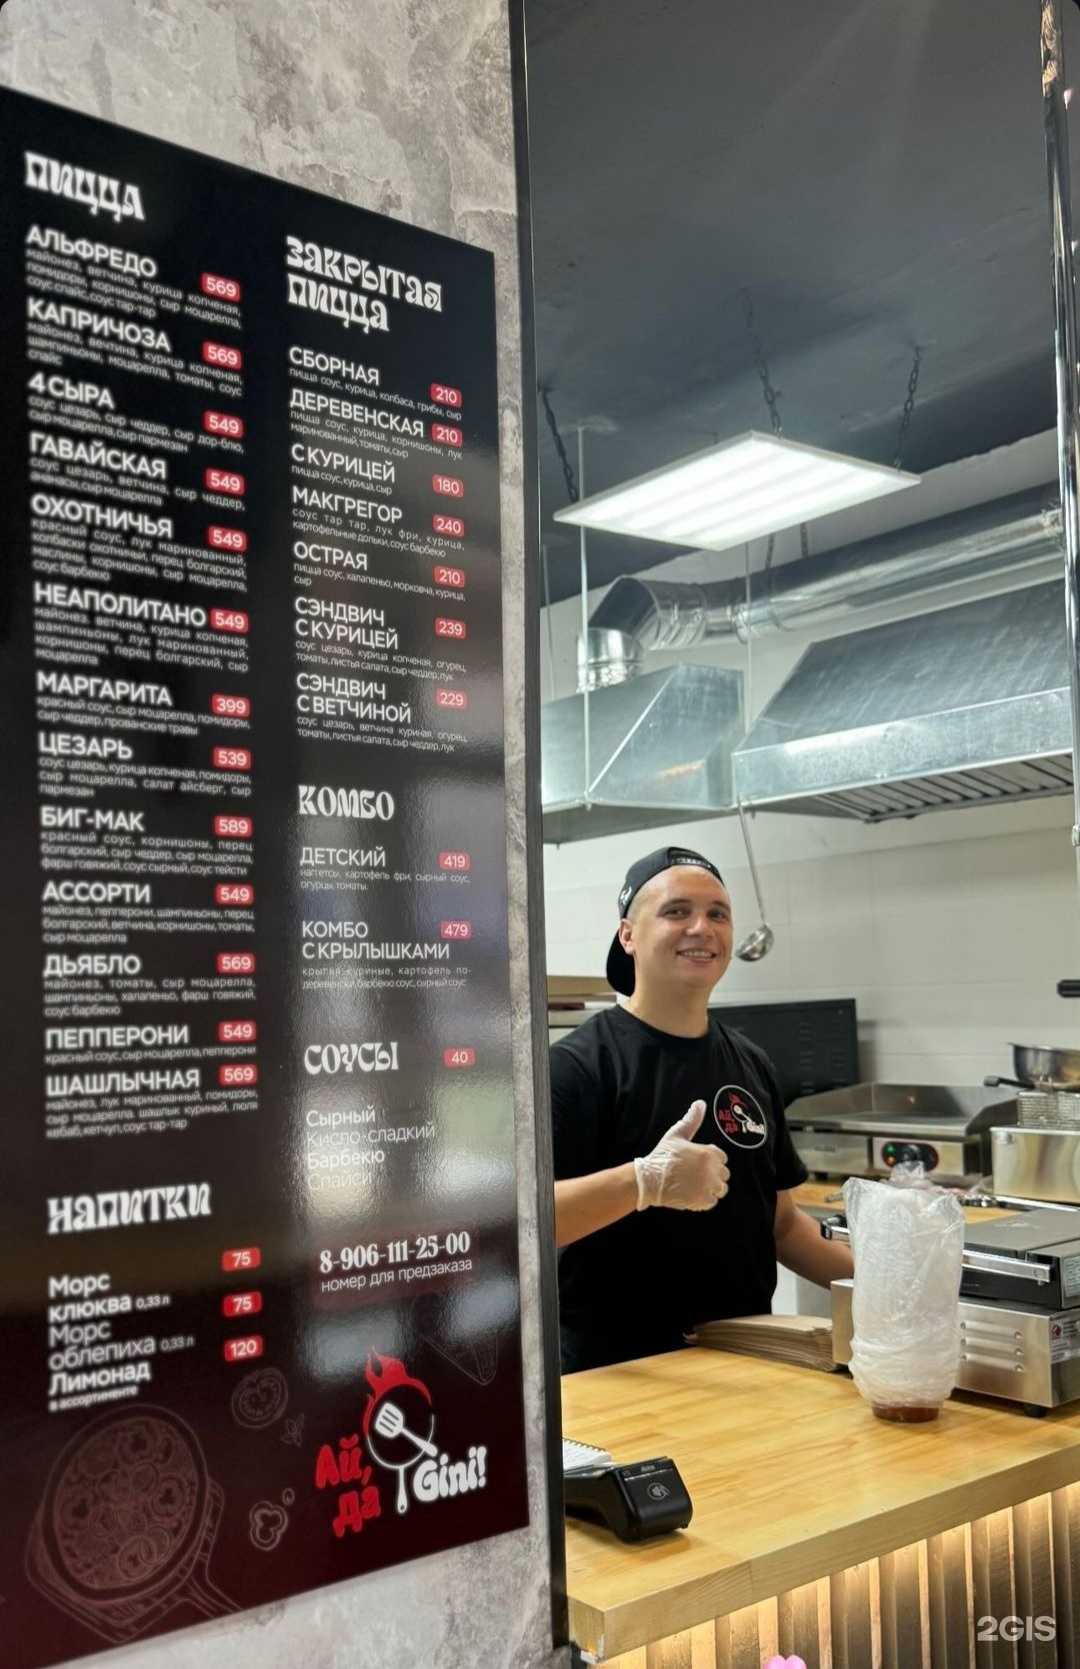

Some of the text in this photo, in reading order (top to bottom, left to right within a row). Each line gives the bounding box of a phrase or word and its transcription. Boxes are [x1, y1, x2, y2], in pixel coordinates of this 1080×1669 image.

[25, 224, 157, 278] АЛЬФРЕДО
[206, 276, 237, 297] 569
[27, 296, 171, 352] КАПРИЧОЗА
[207, 344, 238, 365] 569
[288, 345, 379, 386] СБОРНАЯ
[28, 371, 115, 409] 4 СЫРА
[435, 386, 457, 404] 210
[208, 414, 239, 434] 549
[289, 387, 424, 438] ДЕРЕВЕНСКАЯ
[436, 426, 458, 443] 210
[29, 431, 166, 479] ГАВАЙСКАЯ
[290, 442, 395, 483] С КУРИЦЕЙ
[210, 471, 240, 492] 549
[437, 477, 459, 494] 180
[30, 492, 172, 538] ОХОТНИЧЬЯ
[292, 485, 403, 524] МАКГРЕГОР
[436, 517, 461, 534] 240
[212, 528, 243, 548] 549
[293, 540, 367, 571] ОСТРАЯ
[439, 569, 461, 585] 210
[33, 581, 206, 627] НЕАПОЛИТАНО
[294, 596, 384, 627] СЭНДВИЧ
[215, 611, 245, 630] 549
[438, 621, 463, 636] 239
[294, 617, 398, 650] С КУРИЦЕЙ
[36, 670, 172, 706] МАРГАРИТА
[296, 672, 386, 700] СЭНДВИЧ
[216, 697, 246, 714] 399
[296, 692, 411, 724] С ВЕТЧИНОЙ
[439, 691, 464, 706] 229
[38, 731, 133, 760] ЦЕЗАРЬ
[218, 749, 247, 766] 539
[298, 784, 395, 821] КОМБО
[40, 805, 144, 832] БИГ-МАК
[218, 818, 248, 834] 589
[299, 844, 385, 867] ДЕТСКИЙ
[444, 855, 465, 867] 419
[42, 880, 150, 903] АССОРТИ
[220, 886, 250, 902] 549
[301, 921, 367, 937] КОМБО
[444, 924, 467, 936] 479
[302, 942, 449, 959] С КРЫЛЫШКАМИ
[42, 953, 141, 977] ДЬЯБЛО
[221, 955, 252, 970] 569
[45, 1024, 188, 1049] ПЕППЕРОНИ
[223, 1023, 253, 1039] 549
[303, 1042, 398, 1075] СОУСЫ
[451, 1051, 467, 1063] 40
[46, 1068, 200, 1096] ШАШЛЫЧНАЯ
[224, 1066, 254, 1082] 569
[305, 1106, 375, 1129] Сырный
[306, 1146, 385, 1172] Барбекю
[232, 1250, 251, 1267] 75
[319, 1230, 471, 1273] 8-906-111-25-00
[48, 1273, 110, 1298] Морс
[321, 1258, 472, 1292] номер для предзаказа
[48, 1294, 132, 1323] клюква
[135, 1294, 161, 1309] 0,33
[233, 1295, 252, 1312] 75
[48, 1320, 111, 1348] Морс
[48, 1336, 155, 1371] облепиха
[160, 1335, 185, 1351] 0,33
[231, 1340, 256, 1358] 120
[50, 1362, 150, 1396] Лимонад
[60, 1386, 138, 1408] ассортименте
[413, 1446, 487, 1502] Gini!
